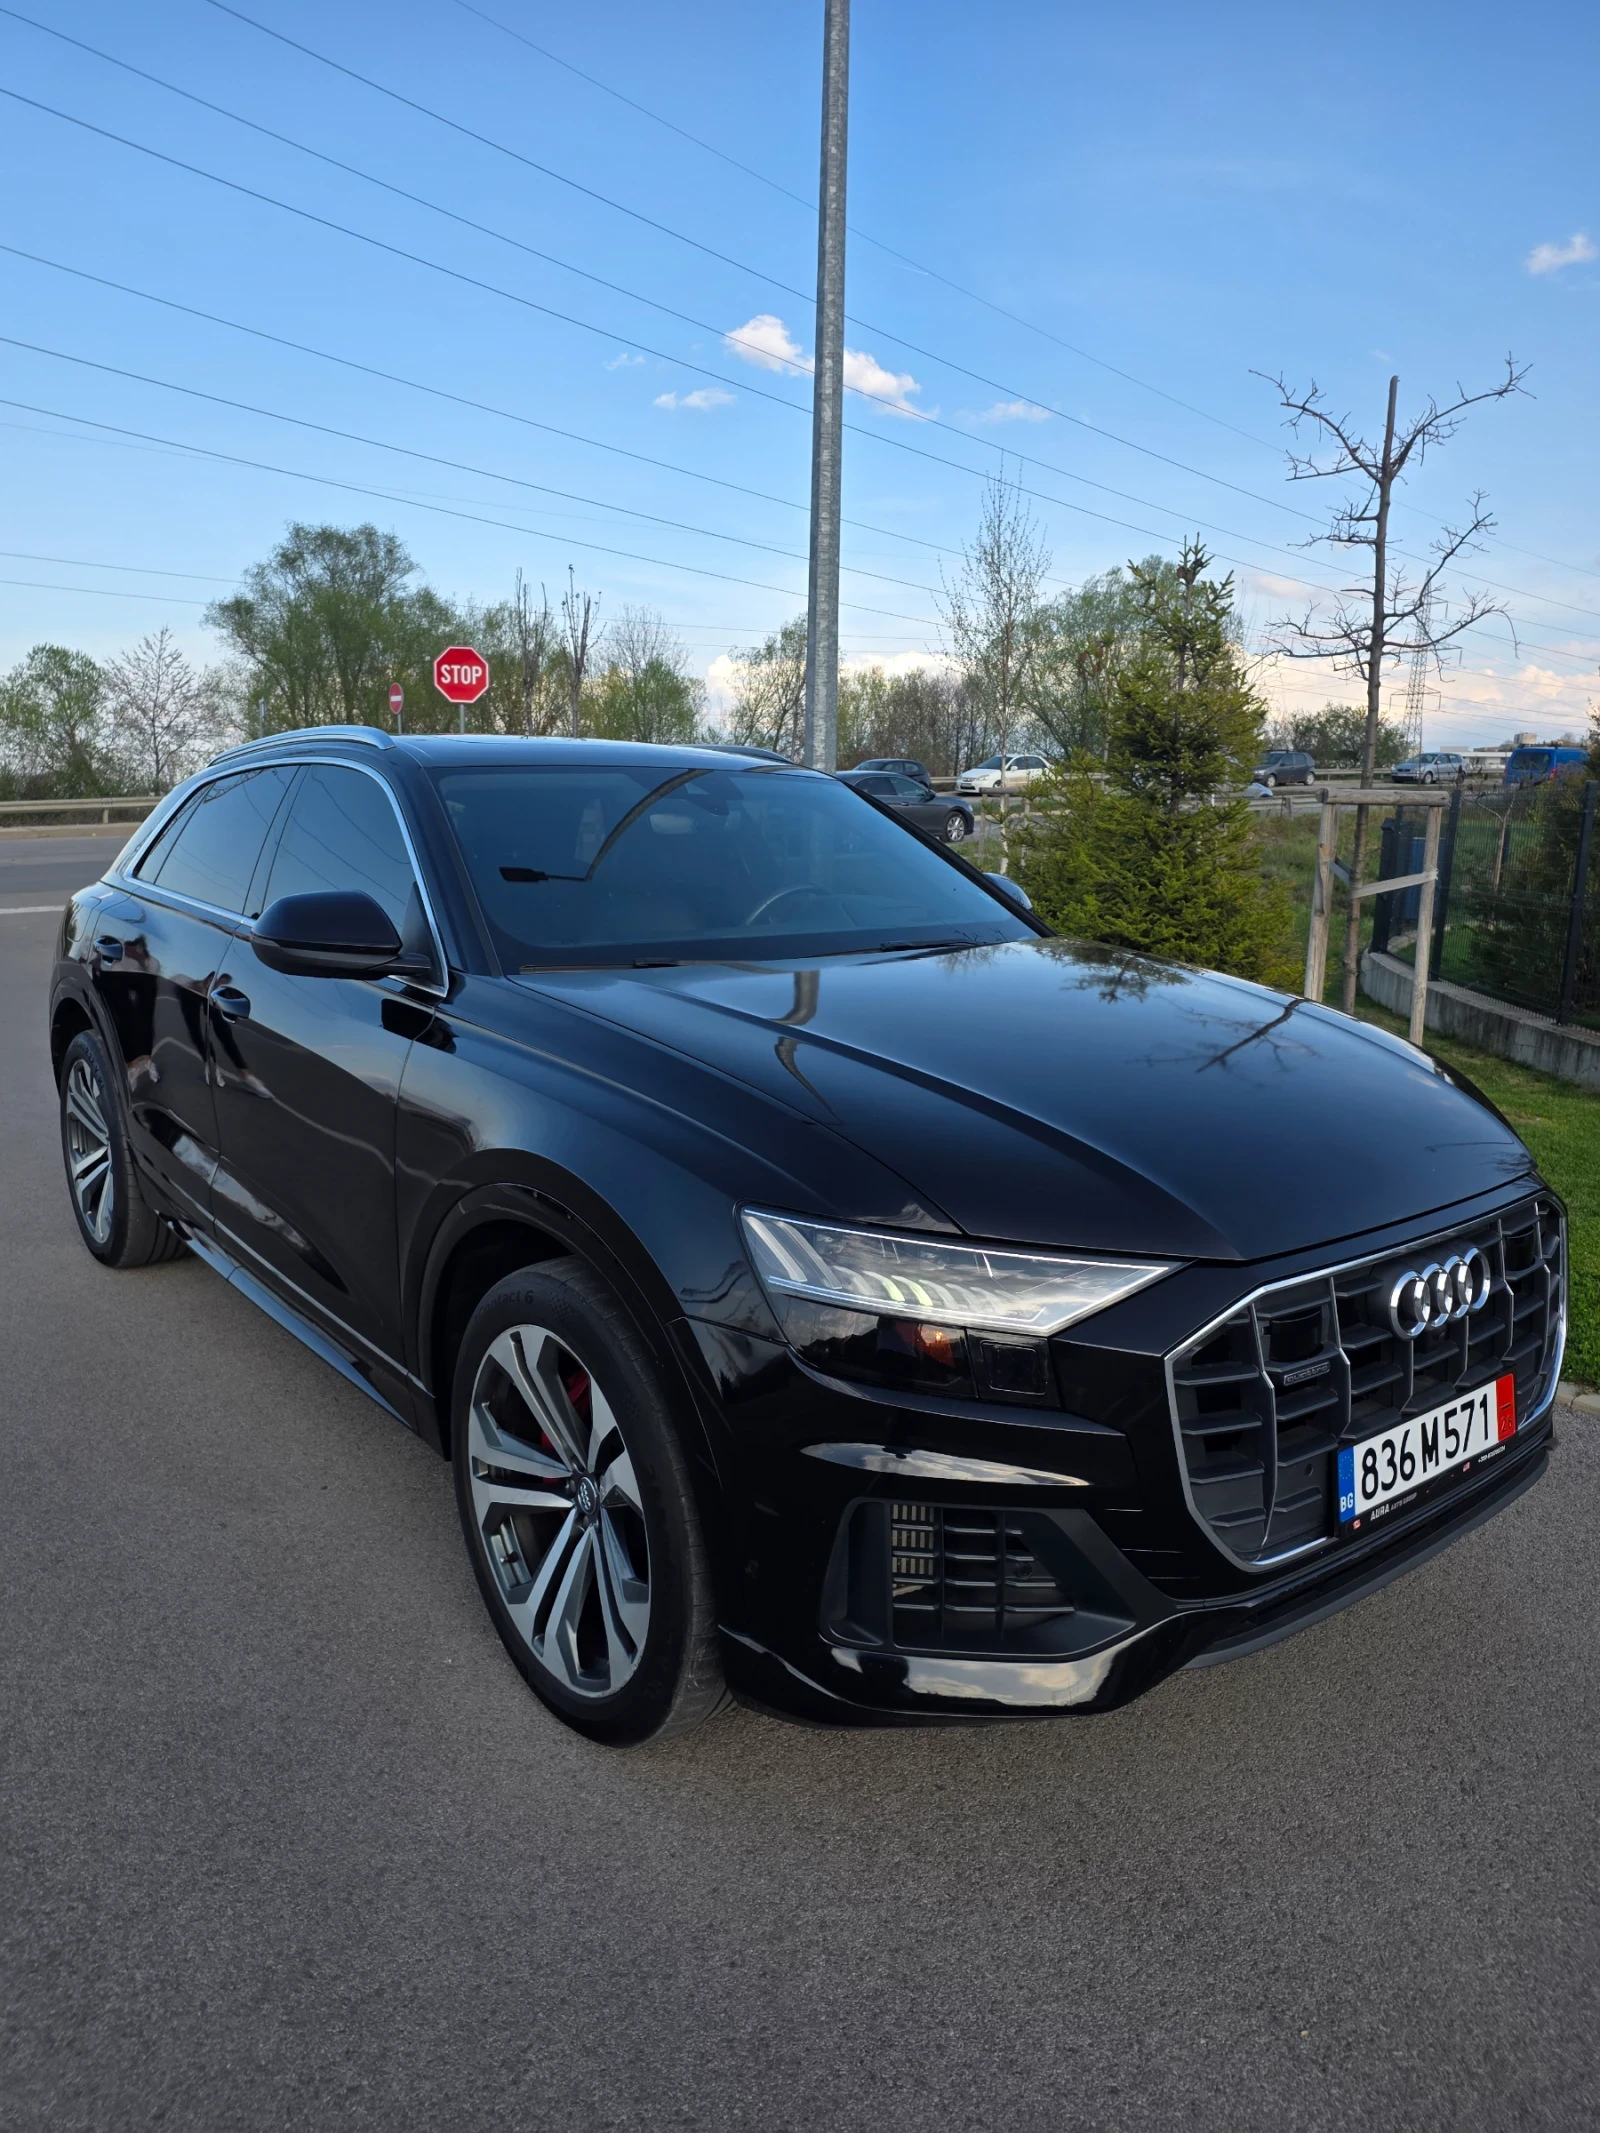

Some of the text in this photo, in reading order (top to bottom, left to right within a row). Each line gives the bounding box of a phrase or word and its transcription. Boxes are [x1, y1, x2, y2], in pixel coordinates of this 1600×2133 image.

[441, 664, 482, 685] STOP
[525, 1289, 534, 1304] 6
[1340, 1492, 1354, 1512] BG
[1370, 1503, 1390, 1521] AURA
